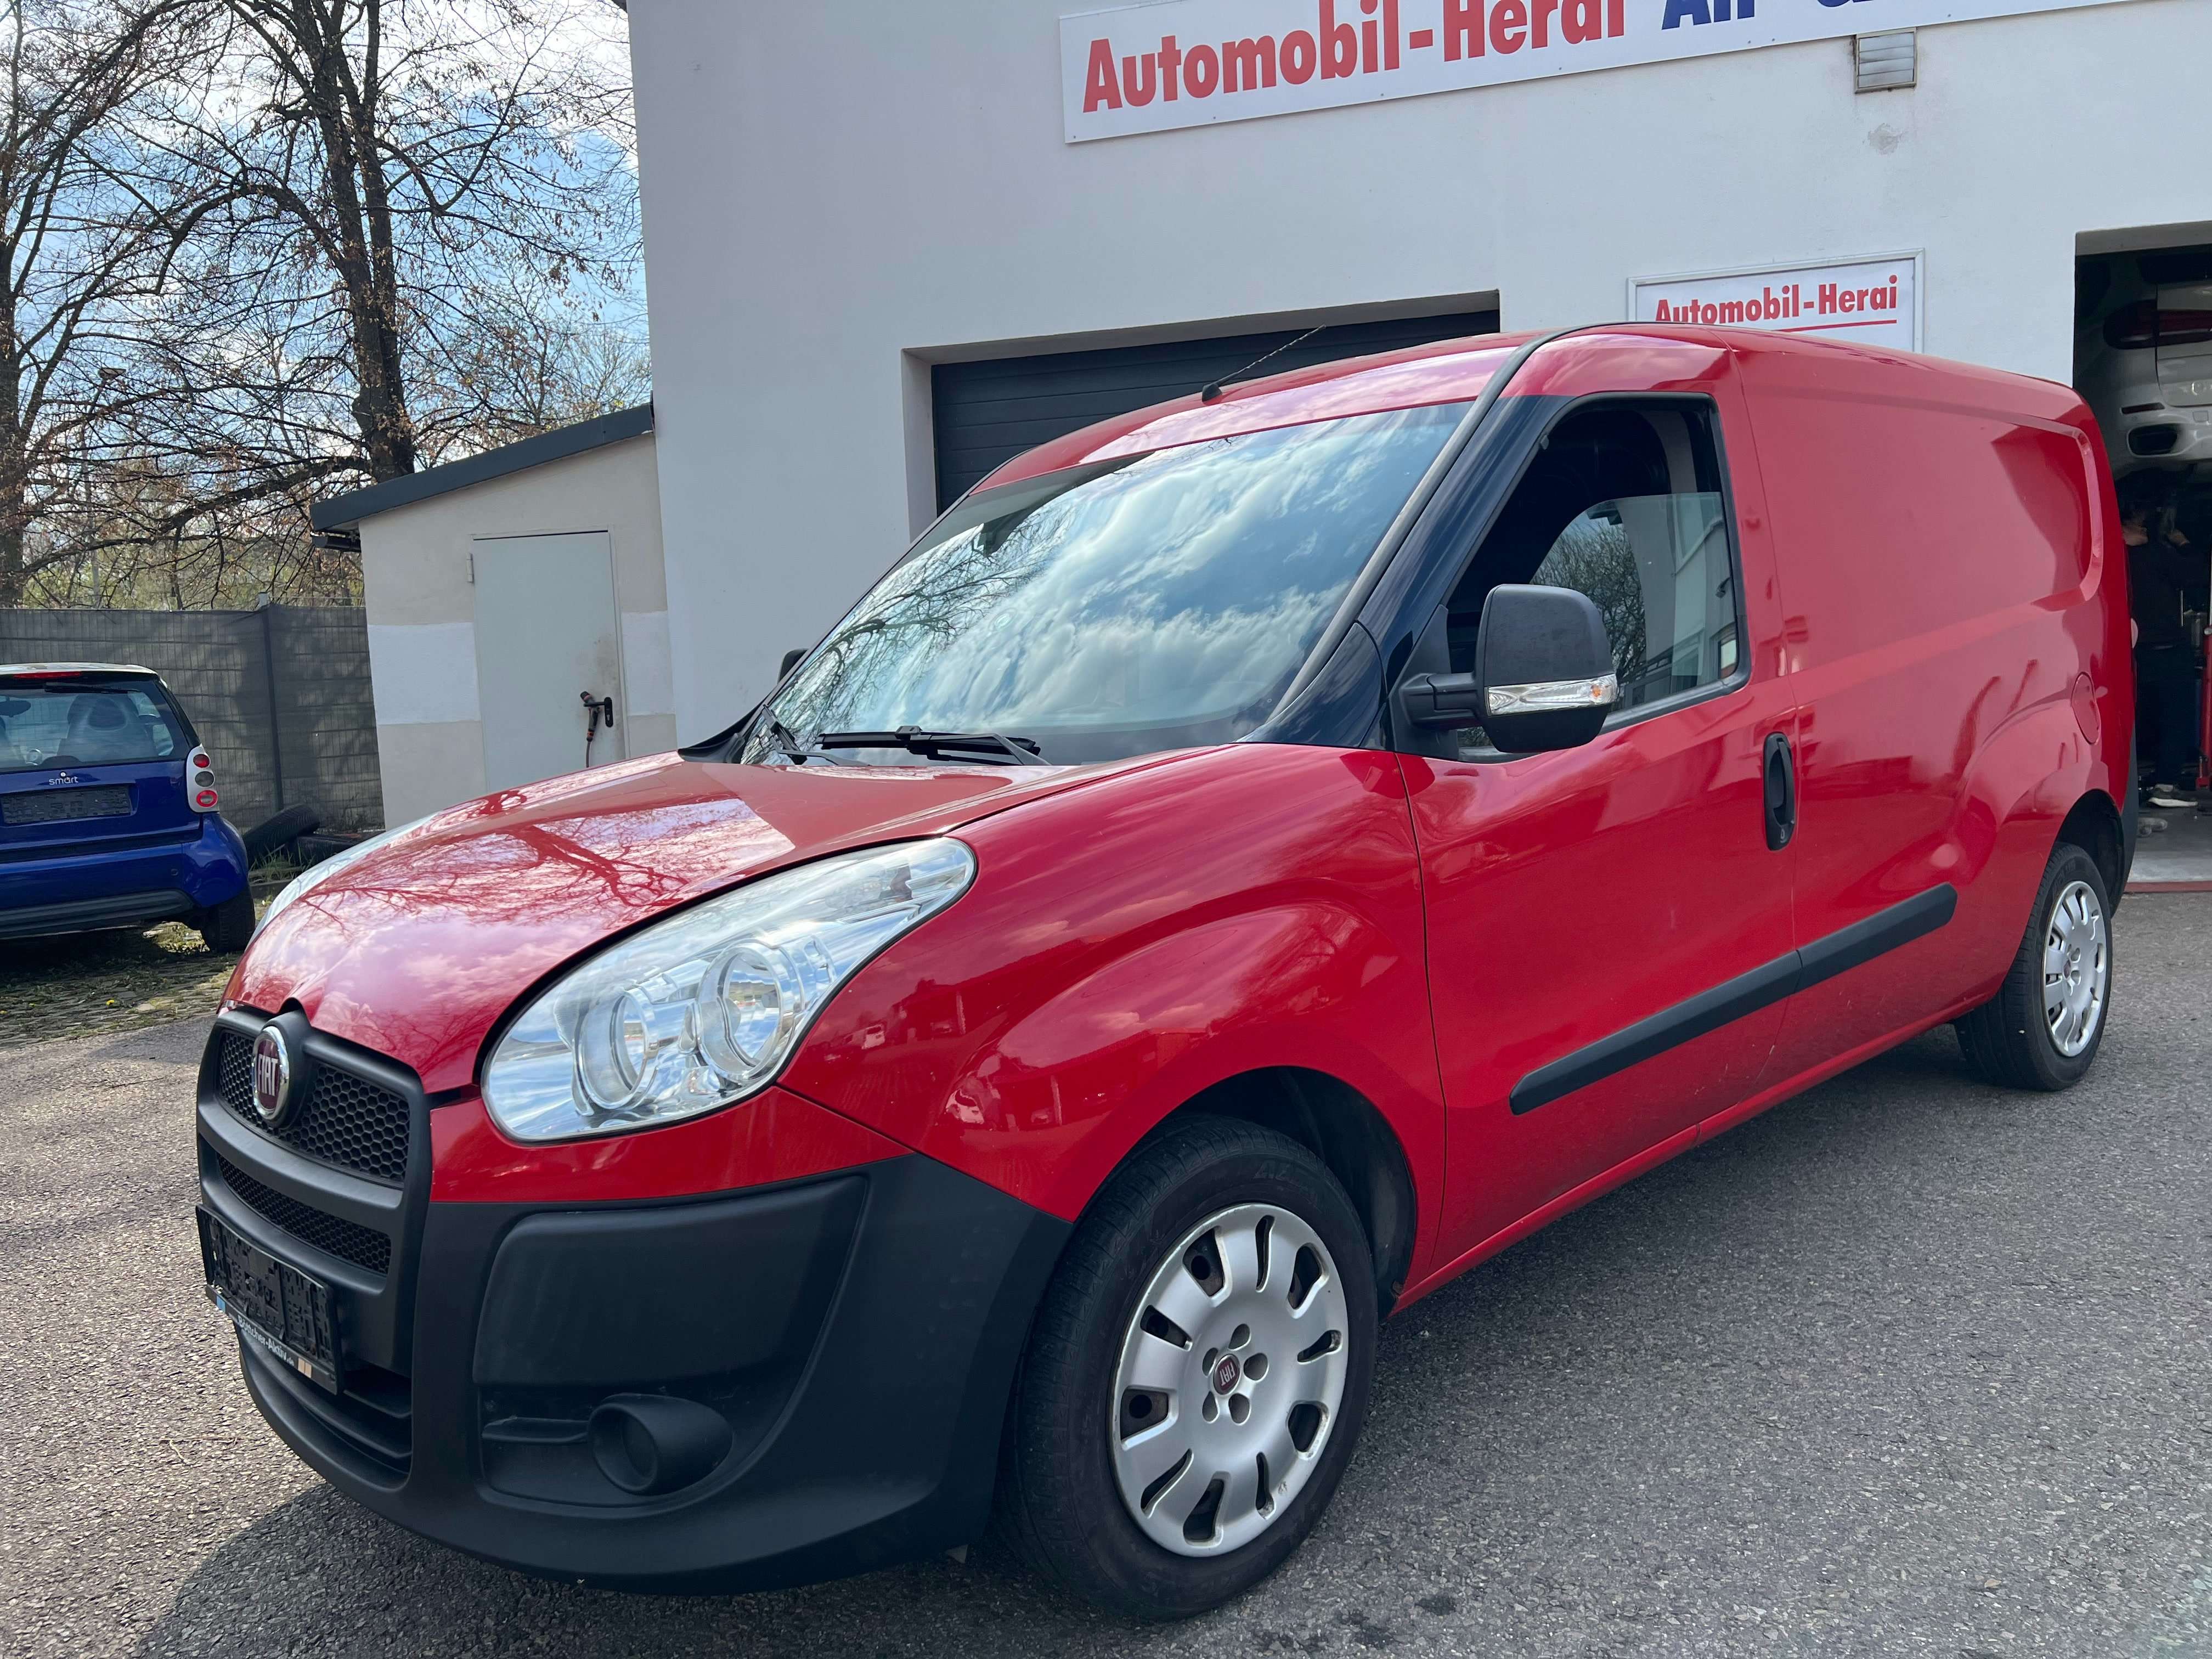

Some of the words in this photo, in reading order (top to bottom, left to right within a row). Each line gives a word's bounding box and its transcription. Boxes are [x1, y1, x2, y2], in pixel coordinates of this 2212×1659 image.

[1656, 274, 1898, 325] Automobil-Herai
[48, 776, 79, 785] smart
[258, 1053, 278, 1097] FIAT
[1220, 1362, 1235, 1386] FIAT
